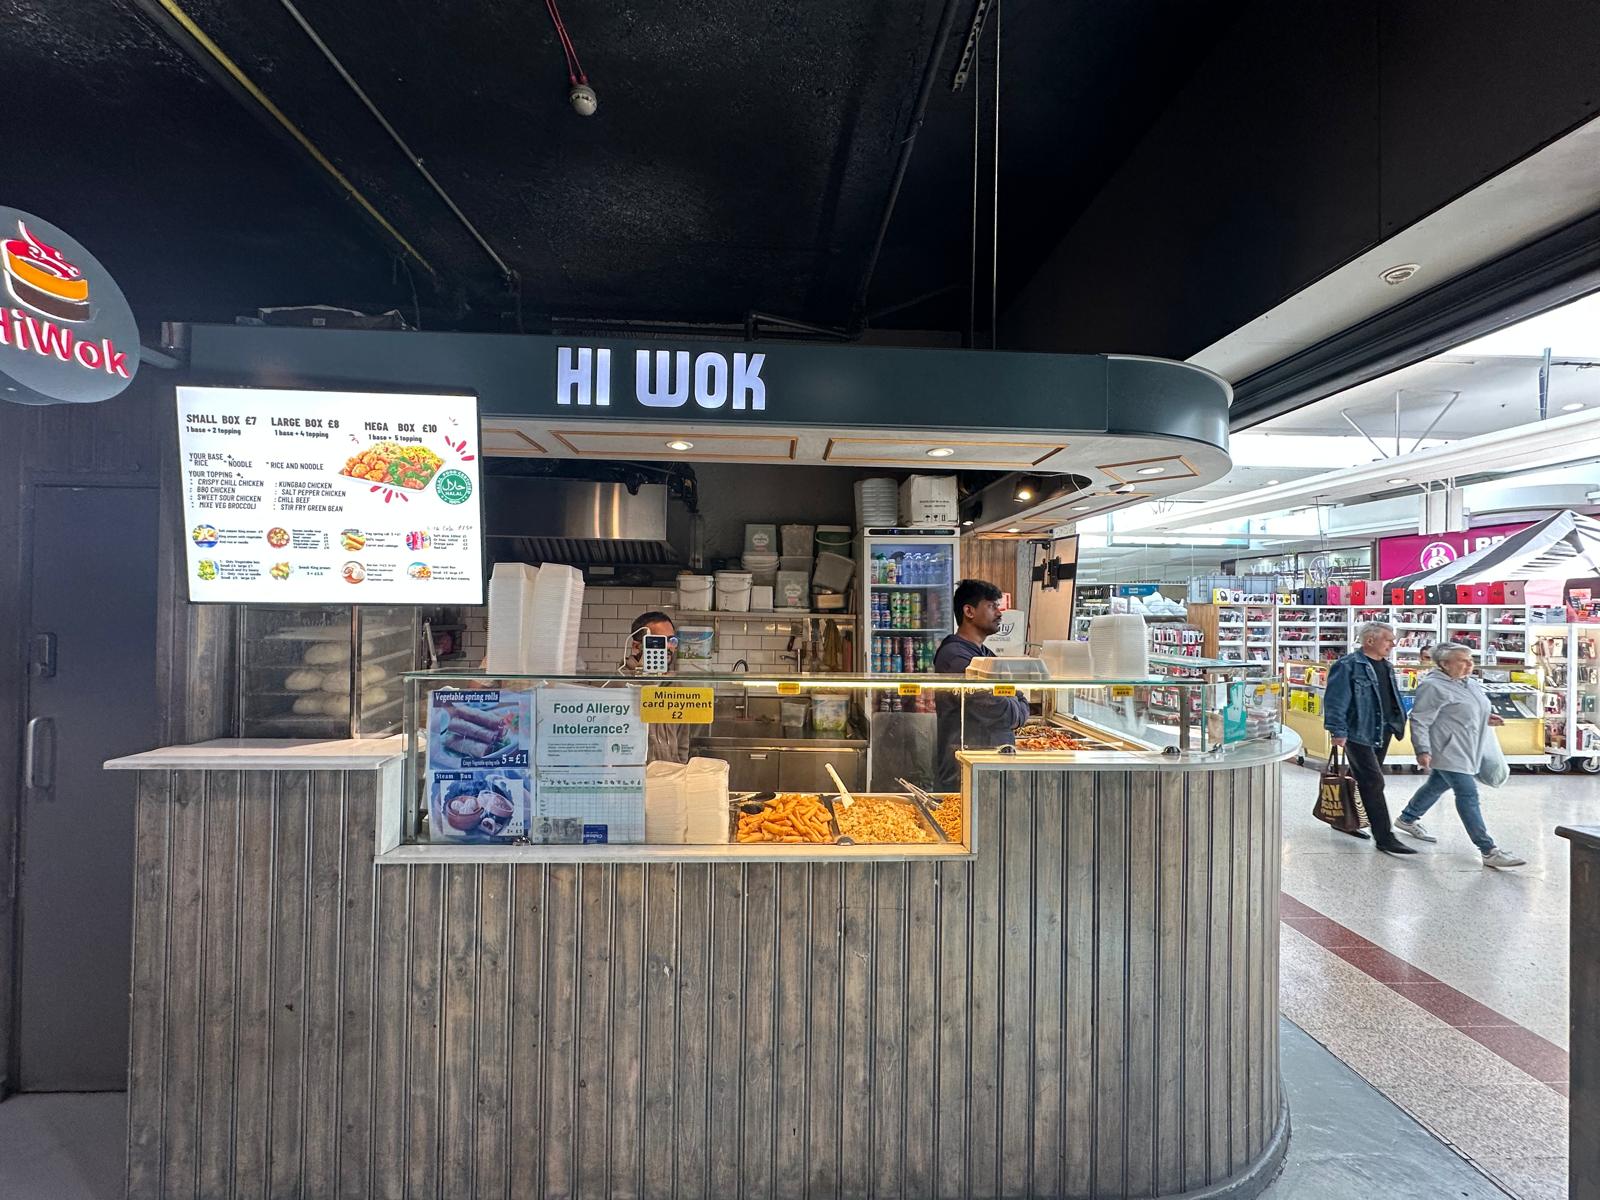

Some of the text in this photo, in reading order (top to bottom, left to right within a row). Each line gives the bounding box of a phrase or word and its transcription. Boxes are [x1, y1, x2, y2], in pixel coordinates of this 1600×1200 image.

[557, 347, 766, 410] HI WOK
[186, 414, 257, 426] SMALL BOX £7
[271, 417, 340, 428] LARGE BOX £8
[218, 428, 242, 436] topping
[364, 422, 438, 433] MEGA BOX £10
[306, 431, 329, 439] topping
[400, 435, 422, 444] topping
[206, 471, 232, 479] TOPPING
[436, 692, 464, 703] Vegetable
[465, 693, 484, 702] spring
[554, 703, 630, 715] Food Allergy
[668, 702, 712, 710] payment
[672, 711, 682, 719] £2
[552, 724, 630, 734] Intolerance?
[502, 754, 507, 764] 5
